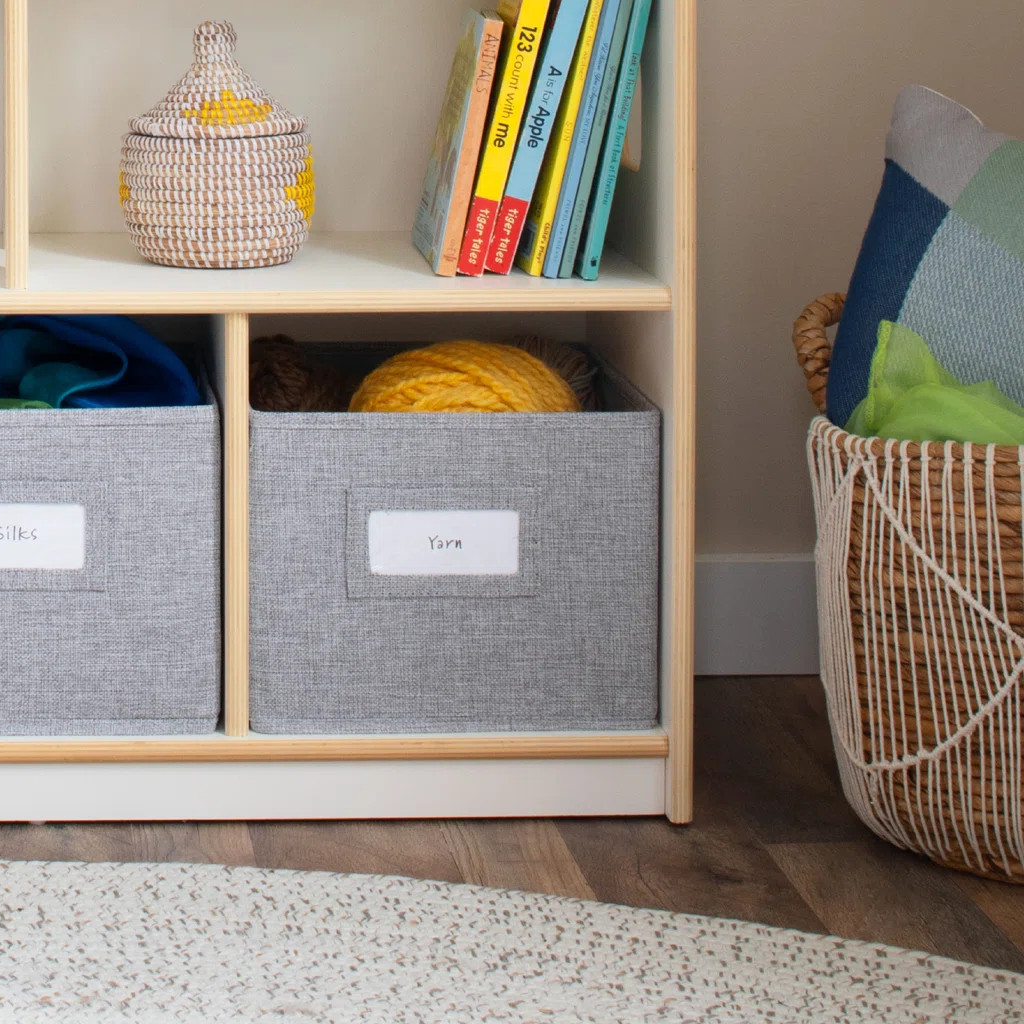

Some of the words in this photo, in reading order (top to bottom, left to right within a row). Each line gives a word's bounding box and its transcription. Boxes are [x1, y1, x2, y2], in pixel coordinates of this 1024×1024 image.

[517, 23, 537, 53] 123
[476, 33, 499, 93] ANIMALS
[629, 67, 634, 75] at
[631, 51, 639, 65] Look
[512, 54, 524, 89] count
[547, 77, 557, 88] is
[548, 65, 563, 79] A
[543, 90, 553, 104] for
[626, 78, 634, 93] That
[503, 91, 516, 119] with
[619, 94, 630, 121] Building!
[493, 122, 509, 148] me
[527, 106, 550, 148] Apple
[615, 131, 623, 147] First
[610, 164, 616, 172] of
[612, 148, 620, 163] Book
[603, 173, 615, 205] Structures
[476, 206, 490, 235] tiger
[504, 206, 519, 235] tiger
[468, 237, 482, 265] tales
[495, 236, 510, 263] tales
[428, 535, 462, 550] Yarn
